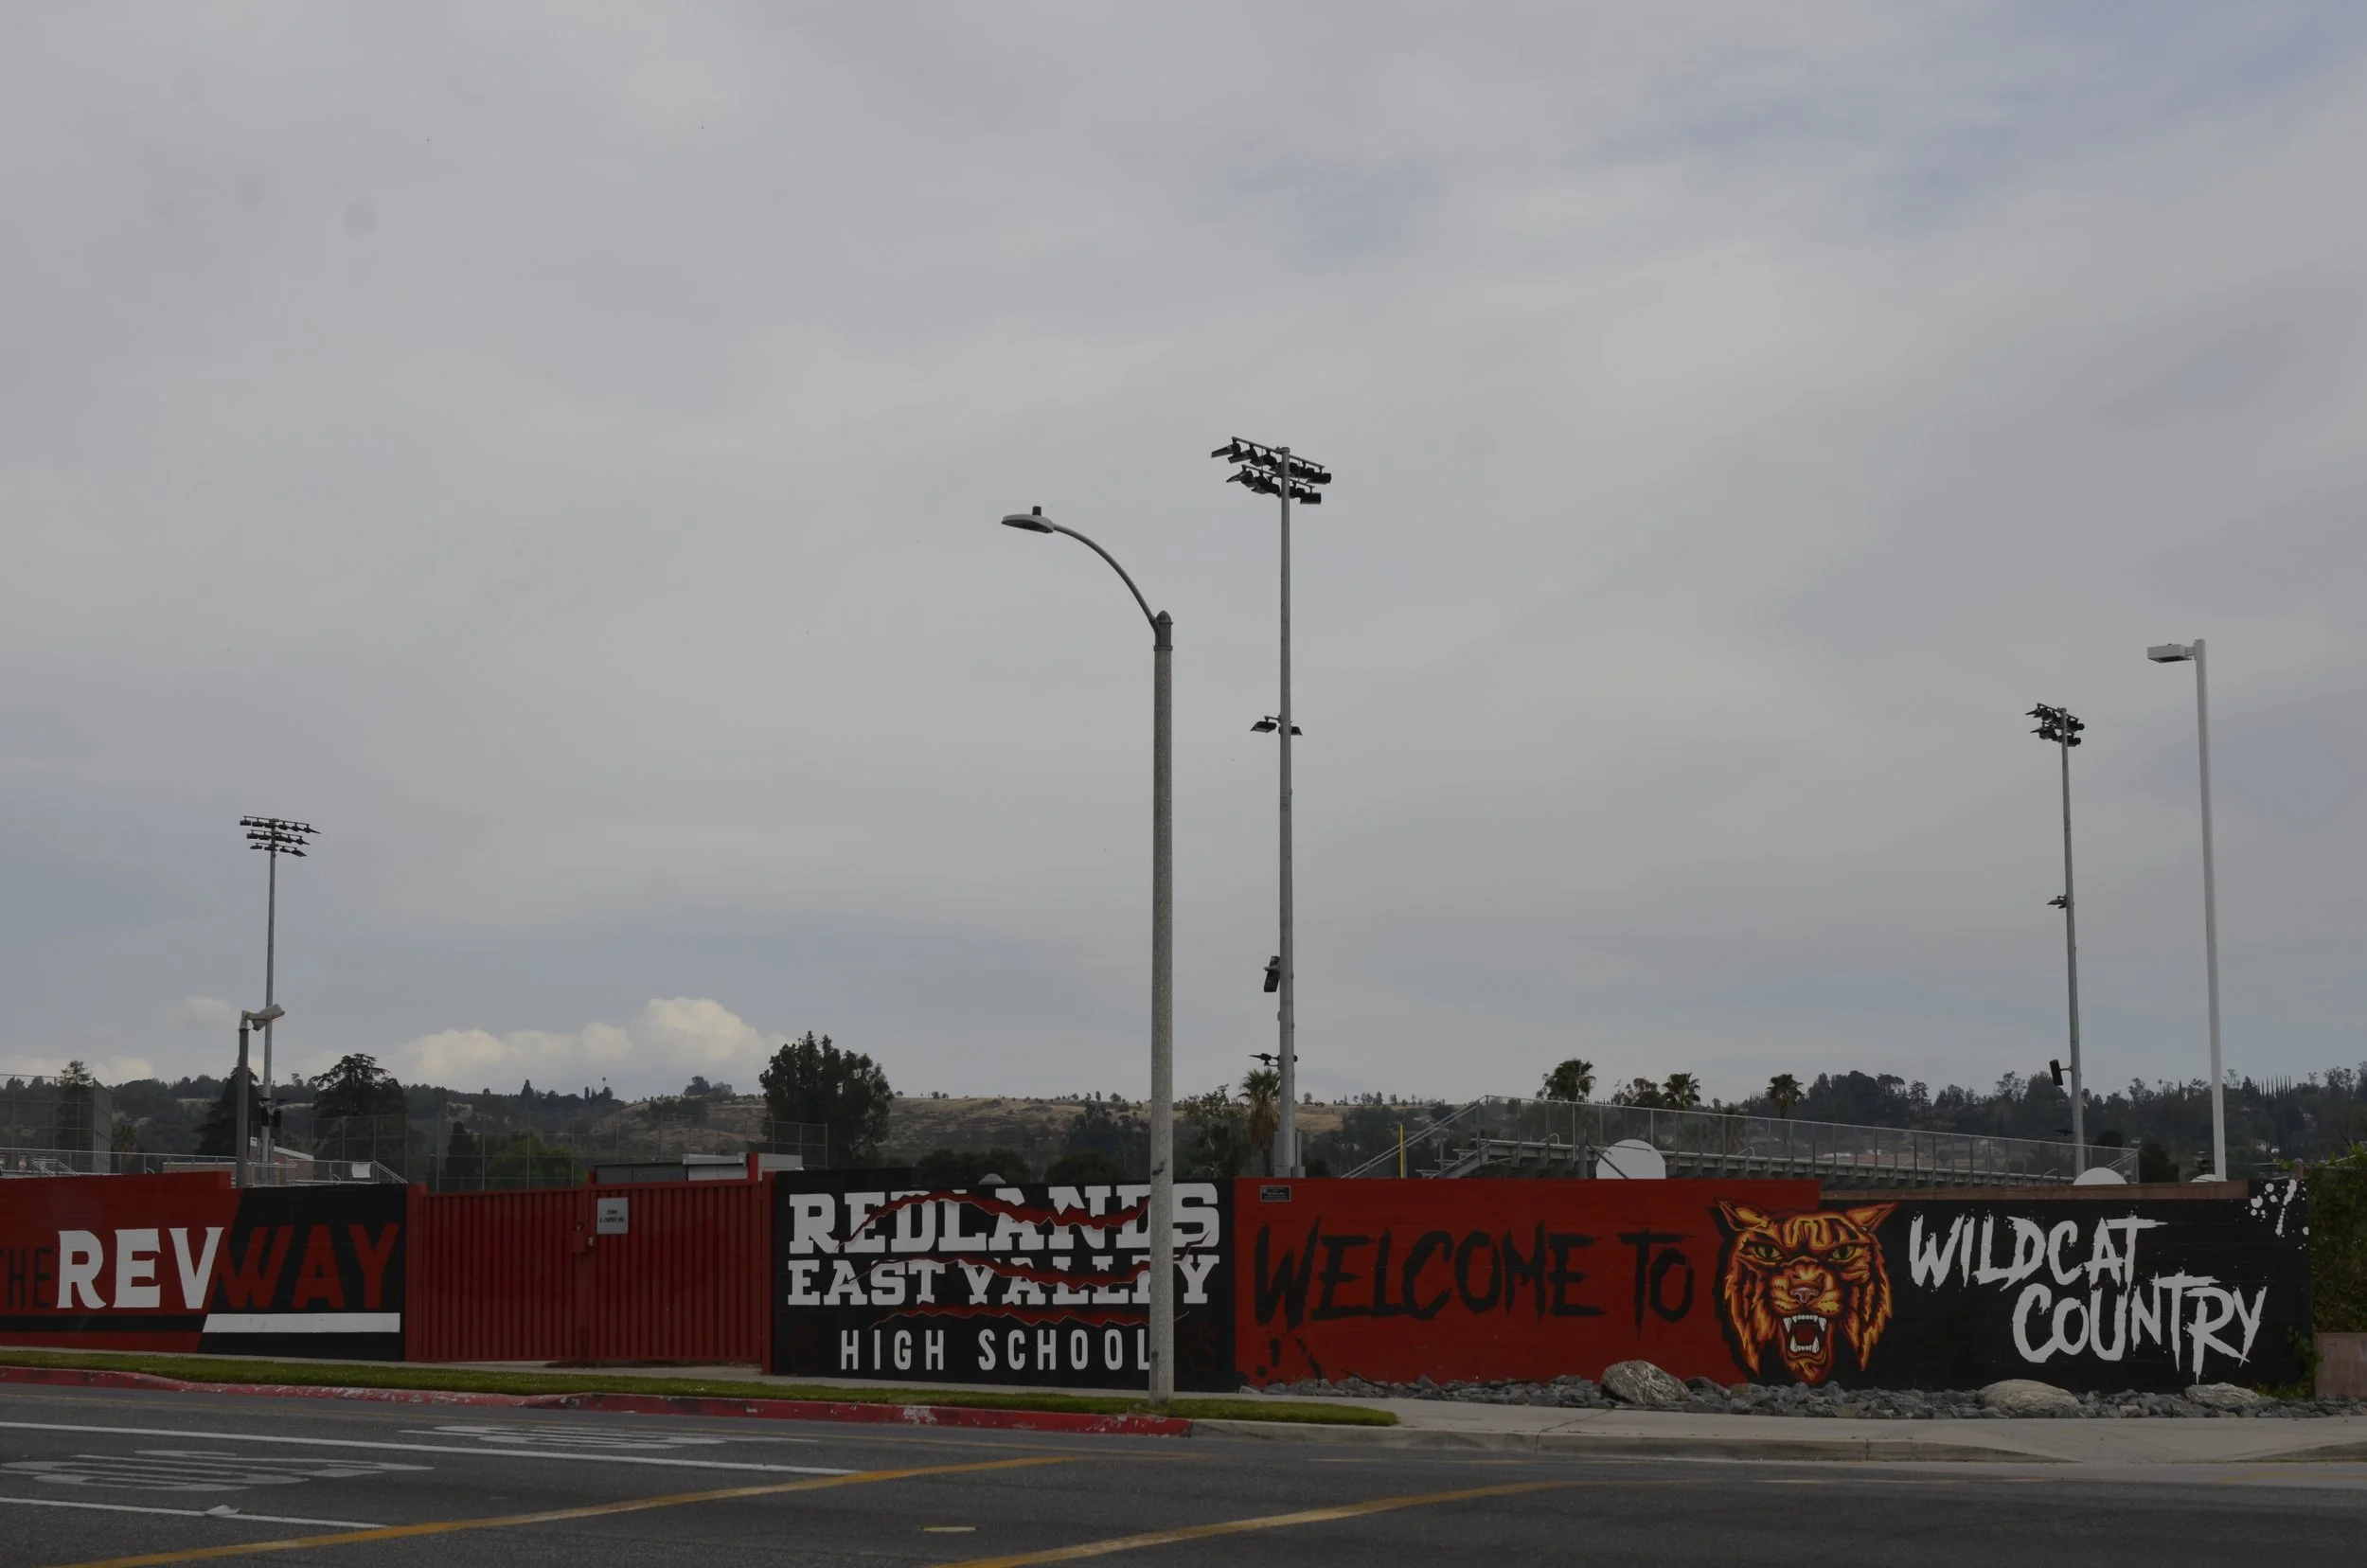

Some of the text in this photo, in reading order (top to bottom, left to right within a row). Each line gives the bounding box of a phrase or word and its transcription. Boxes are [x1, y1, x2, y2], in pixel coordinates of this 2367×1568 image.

[788, 1182, 1220, 1255] REDLANDS
[1909, 1210, 2168, 1292] WILDCAT
[0, 1223, 400, 1310] HE REV WAY
[788, 1257, 946, 1306] EAST
[1255, 1216, 1698, 1339] WELCOME TO
[840, 1328, 1150, 1371] HIGH SCHOOL
[2011, 1272, 2268, 1385] COUNTRY
